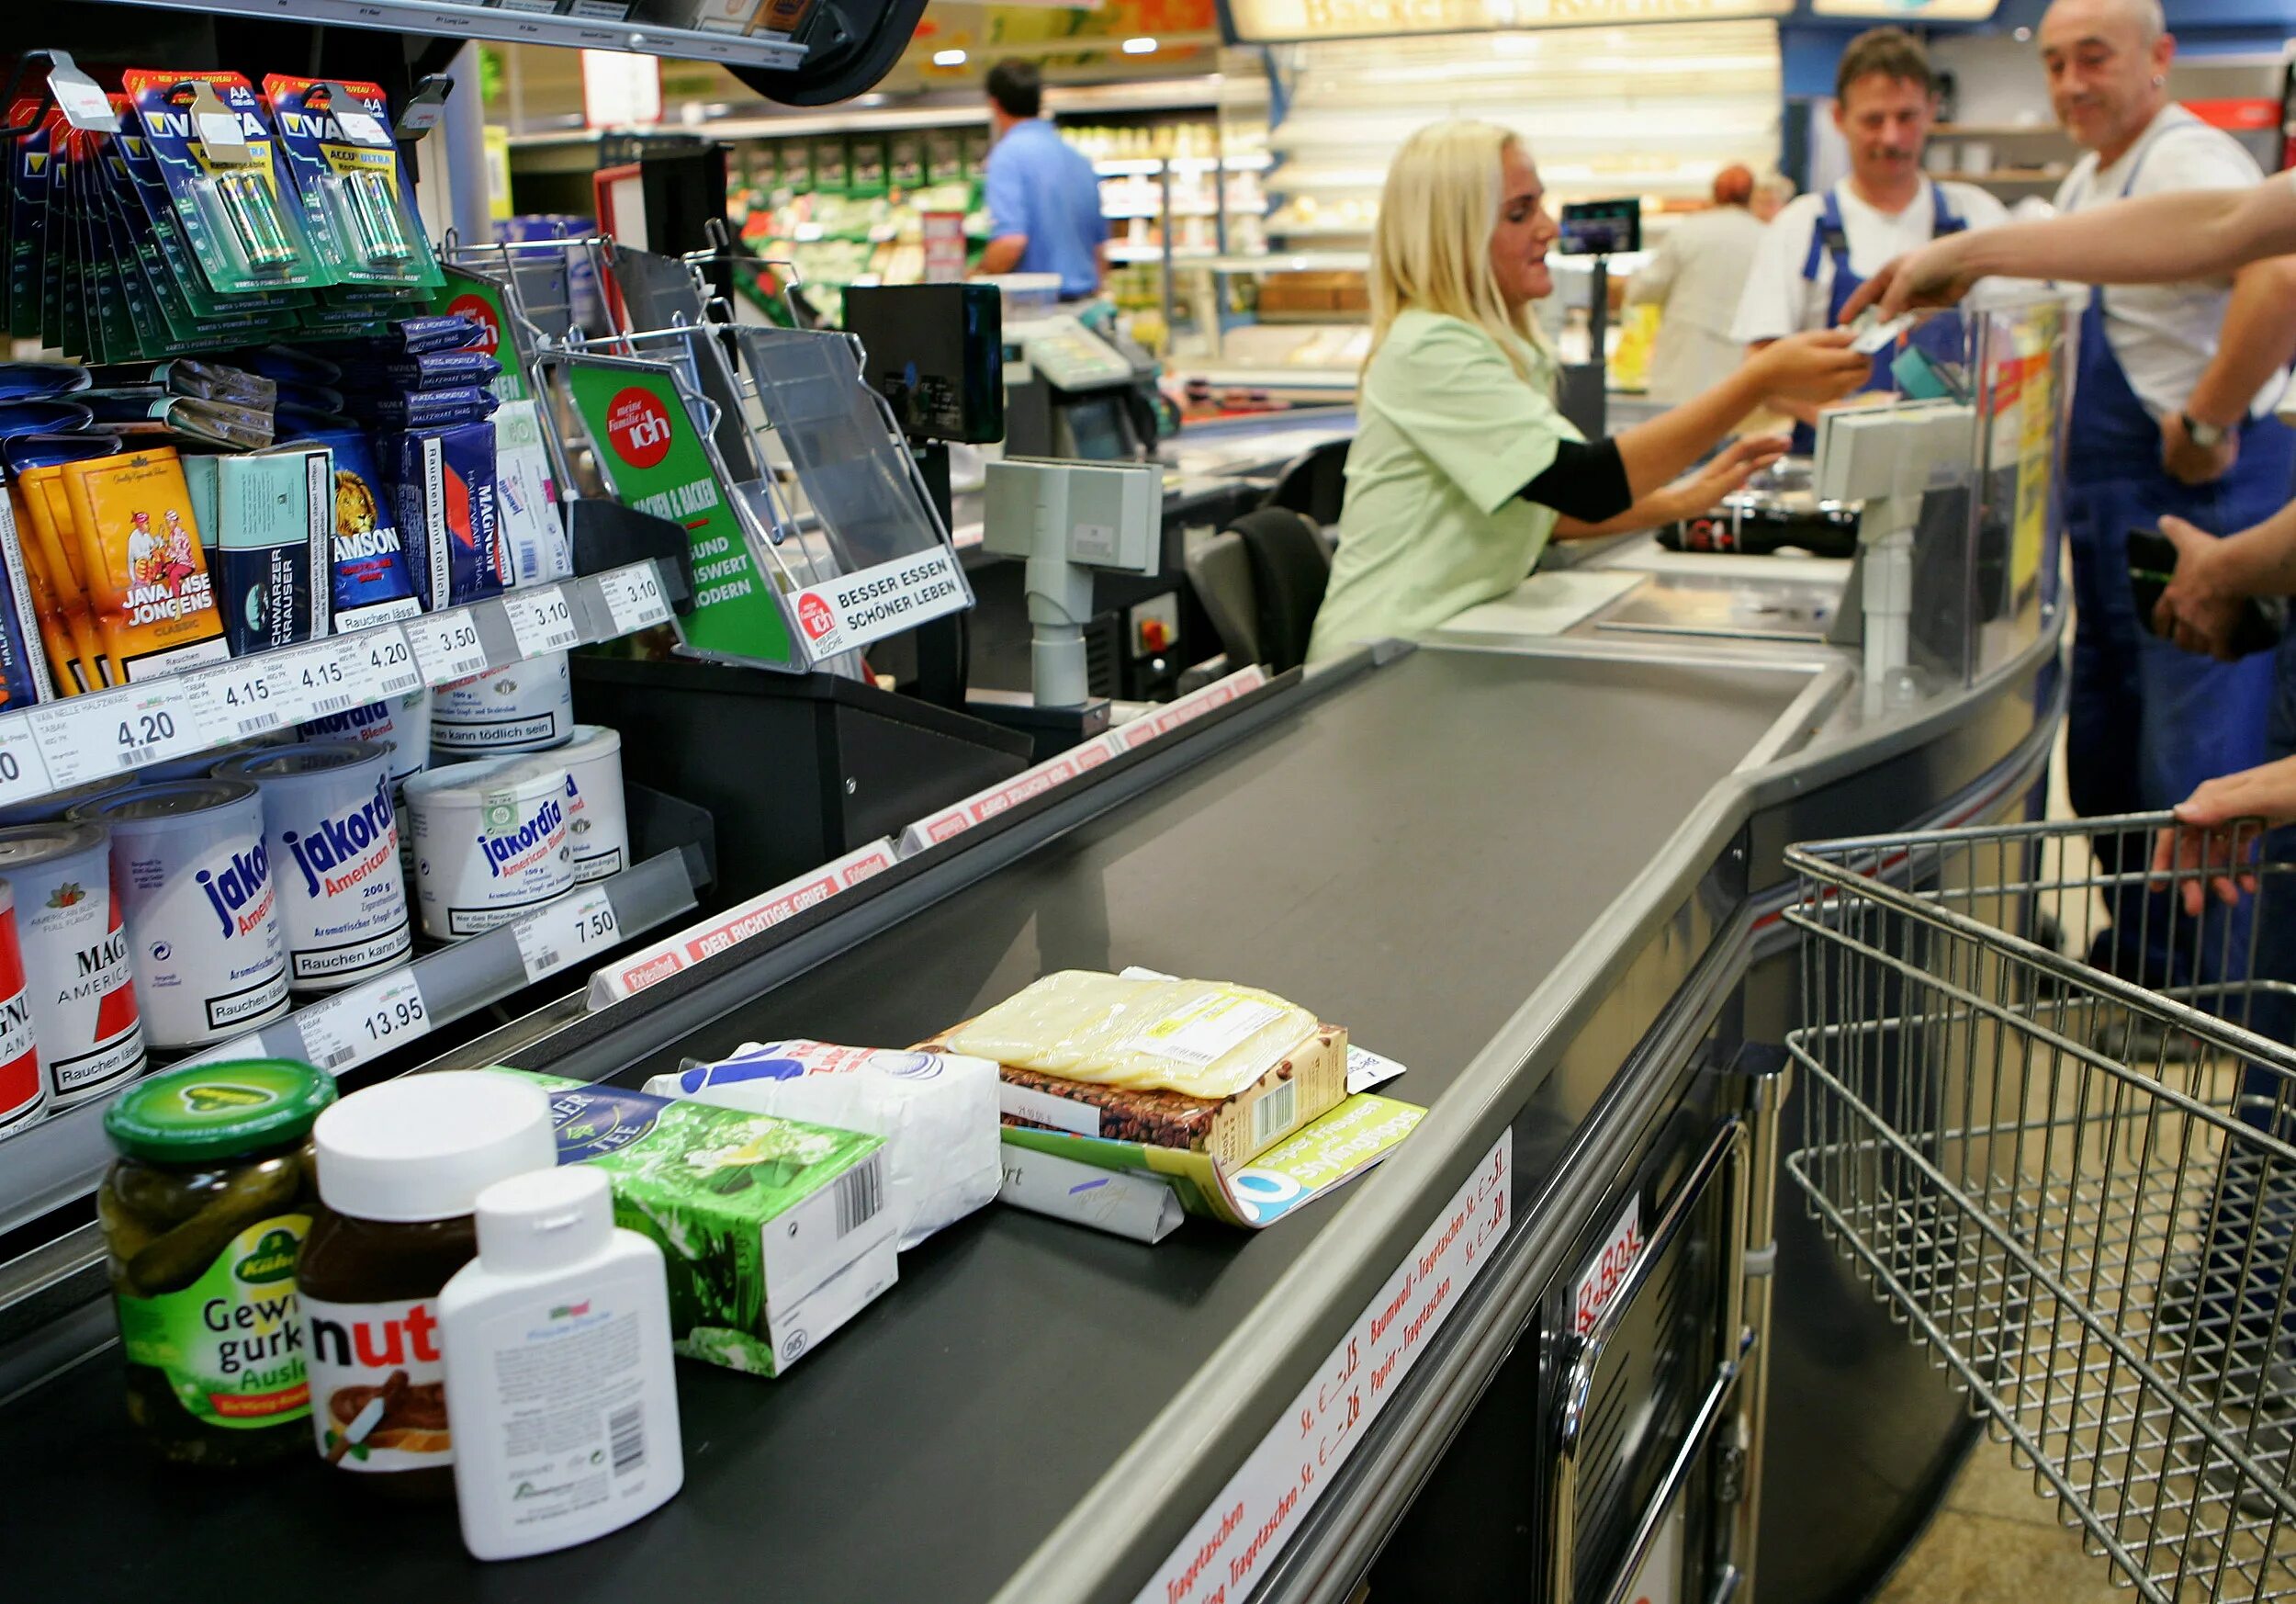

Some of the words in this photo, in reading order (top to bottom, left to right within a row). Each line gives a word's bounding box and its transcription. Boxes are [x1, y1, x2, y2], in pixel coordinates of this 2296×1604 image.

[231, 86, 250, 99] AA
[364, 98, 382, 111] AA
[331, 151, 355, 161] ACCU
[360, 152, 391, 164] ULTRA
[629, 409, 670, 449] ich
[429, 448, 439, 507] Rauchen
[333, 527, 401, 563] AMSON
[432, 512, 441, 546] kann
[467, 469, 482, 551] HALFZWARE
[475, 557, 483, 592] SHAG
[478, 484, 497, 572] MAGNUM
[434, 550, 445, 599] tödlich
[627, 581, 657, 603] 3.10
[838, 576, 899, 609] BESSER
[901, 558, 949, 586] ESSEN
[129, 591, 213, 627] JONGENS
[271, 548, 282, 649] CHWARZER
[281, 559, 293, 645] KRAUSER
[535, 602, 568, 626] 3.10
[847, 596, 914, 631] SCHÖNER
[917, 579, 958, 605] LEBEN
[344, 612, 391, 630] Rauchen
[440, 627, 476, 651] 3.50
[811, 610, 837, 634] ich
[370, 643, 408, 669] 4.20
[226, 679, 269, 707] 4.15
[302, 662, 343, 689] 4.15
[118, 711, 176, 748] 4.20
[358, 720, 394, 743] Blend
[448, 729, 477, 741] kann
[479, 725, 523, 740] tödlich
[525, 722, 549, 735] sein
[282, 772, 395, 898] jakordi
[477, 799, 563, 878] jakordia
[324, 843, 391, 898] American
[501, 846, 549, 878] American
[363, 880, 383, 898] 200
[383, 880, 390, 893] g
[313, 918, 370, 938] Aromatischer
[372, 910, 392, 926] Stopf-
[575, 910, 613, 943] 7.50
[701, 932, 729, 957] DER
[731, 902, 792, 941] RICHTIGE
[793, 884, 828, 911] GRIFF
[75, 932, 126, 979] MAG
[301, 951, 365, 972] Rauchen
[367, 939, 395, 959] kann
[216, 993, 268, 1020] Rauchen
[365, 996, 423, 1040] 13.95
[62, 1056, 120, 1083] Rauchen
[586, 1124, 642, 1151] TEE
[1370, 1271, 1412, 1348] Baumwoll
[1418, 1212, 1465, 1282] Tragetaschen
[1478, 1177, 1484, 1203] €
[204, 1293, 299, 1333] Gew
[1371, 1344, 1397, 1397] Papier
[1403, 1276, 1451, 1351] Tragetaschen
[1478, 1222, 1484, 1248] €
[220, 1320, 303, 1373] gurk
[310, 1304, 443, 1369] nut
[1166, 1500, 1244, 1604] Tragetaschen
[1318, 1383, 1327, 1414] €
[1229, 1485, 1298, 1588] Tragetaschen
[1318, 1436, 1327, 1467] €
